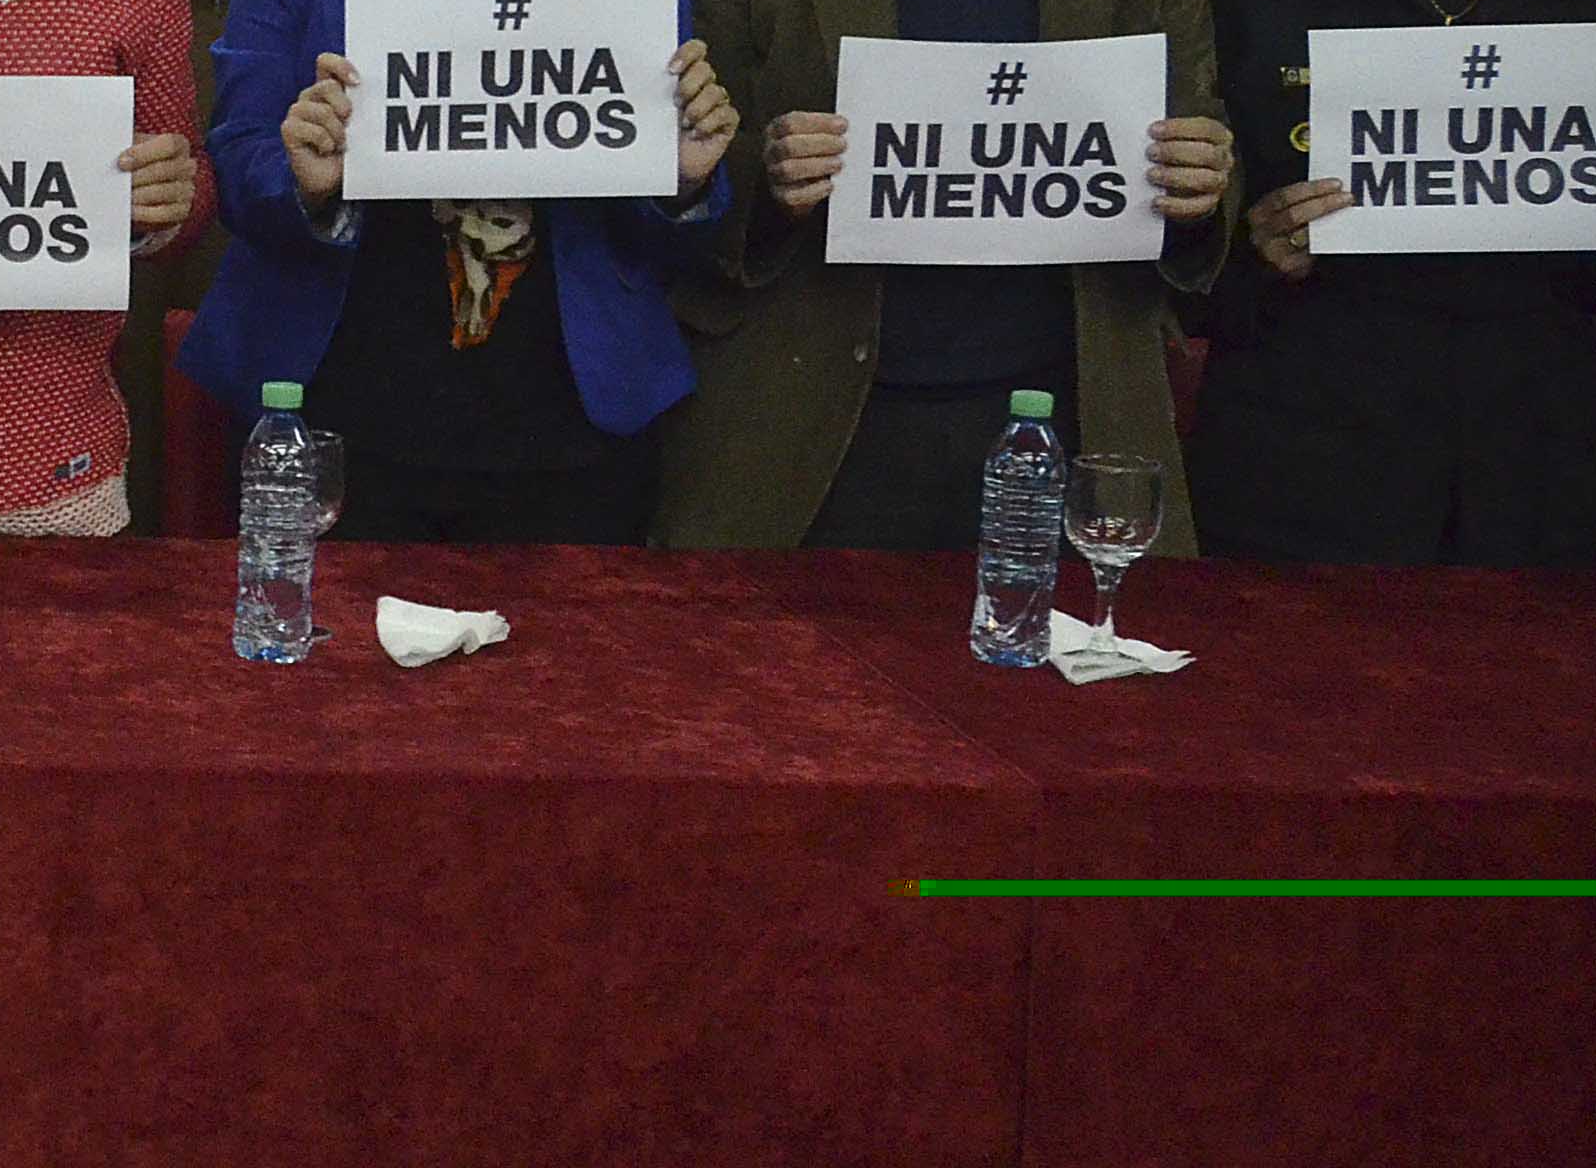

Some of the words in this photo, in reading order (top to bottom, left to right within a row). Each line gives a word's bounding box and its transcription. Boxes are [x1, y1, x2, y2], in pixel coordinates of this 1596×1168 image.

[385, 50, 451, 100] NI
[479, 46, 625, 98] UNA
[986, 61, 1028, 106] #
[1461, 43, 1502, 90] #
[384, 98, 638, 153] MENOS
[872, 121, 941, 170] NI
[969, 120, 1118, 169] UNA
[1351, 108, 1420, 156] NI
[1447, 105, 1596, 154] UNA
[868, 171, 1129, 220] MENOS
